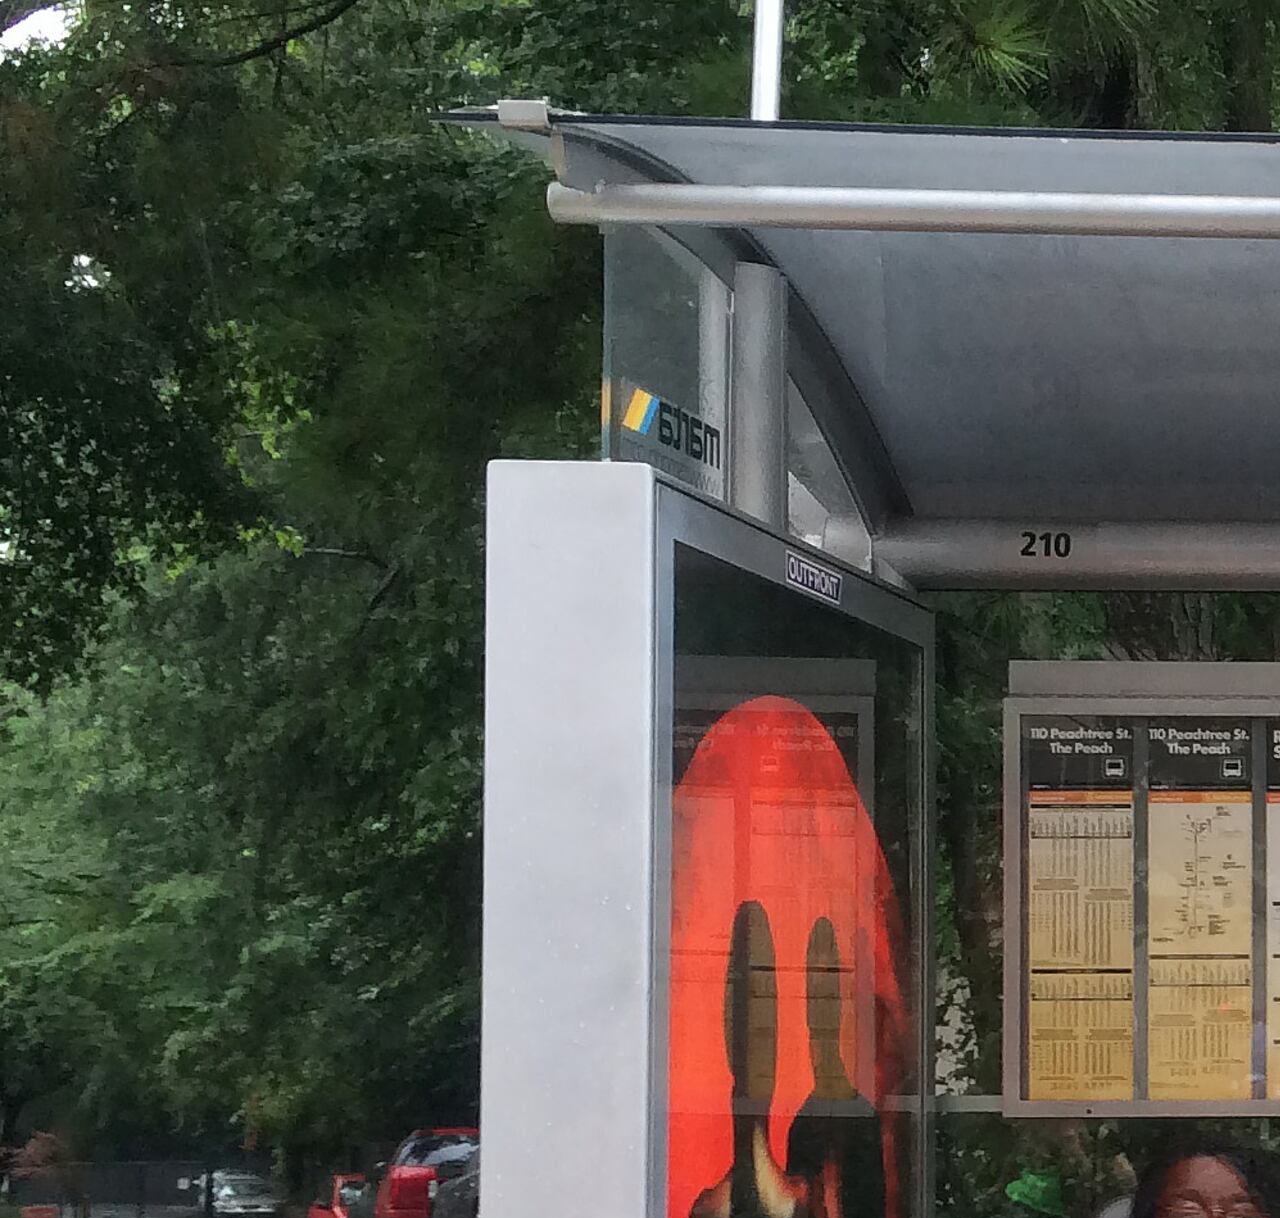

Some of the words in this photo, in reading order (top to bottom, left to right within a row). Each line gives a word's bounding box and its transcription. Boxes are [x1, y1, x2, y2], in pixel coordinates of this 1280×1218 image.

[1020, 531, 1071, 557] 210
[788, 556, 839, 599] OUTFRONT
[1030, 728, 1049, 739] 110
[1050, 726, 1114, 740] Peachtree
[1116, 728, 1132, 740] St.
[1149, 728, 1166, 740] 110
[1168, 727, 1231, 740] Peachtree
[1234, 728, 1250, 740] St.
[1050, 741, 1072, 754] The
[1075, 741, 1113, 754] Peach
[1167, 742, 1190, 754] The
[1192, 742, 1231, 754] Peach
